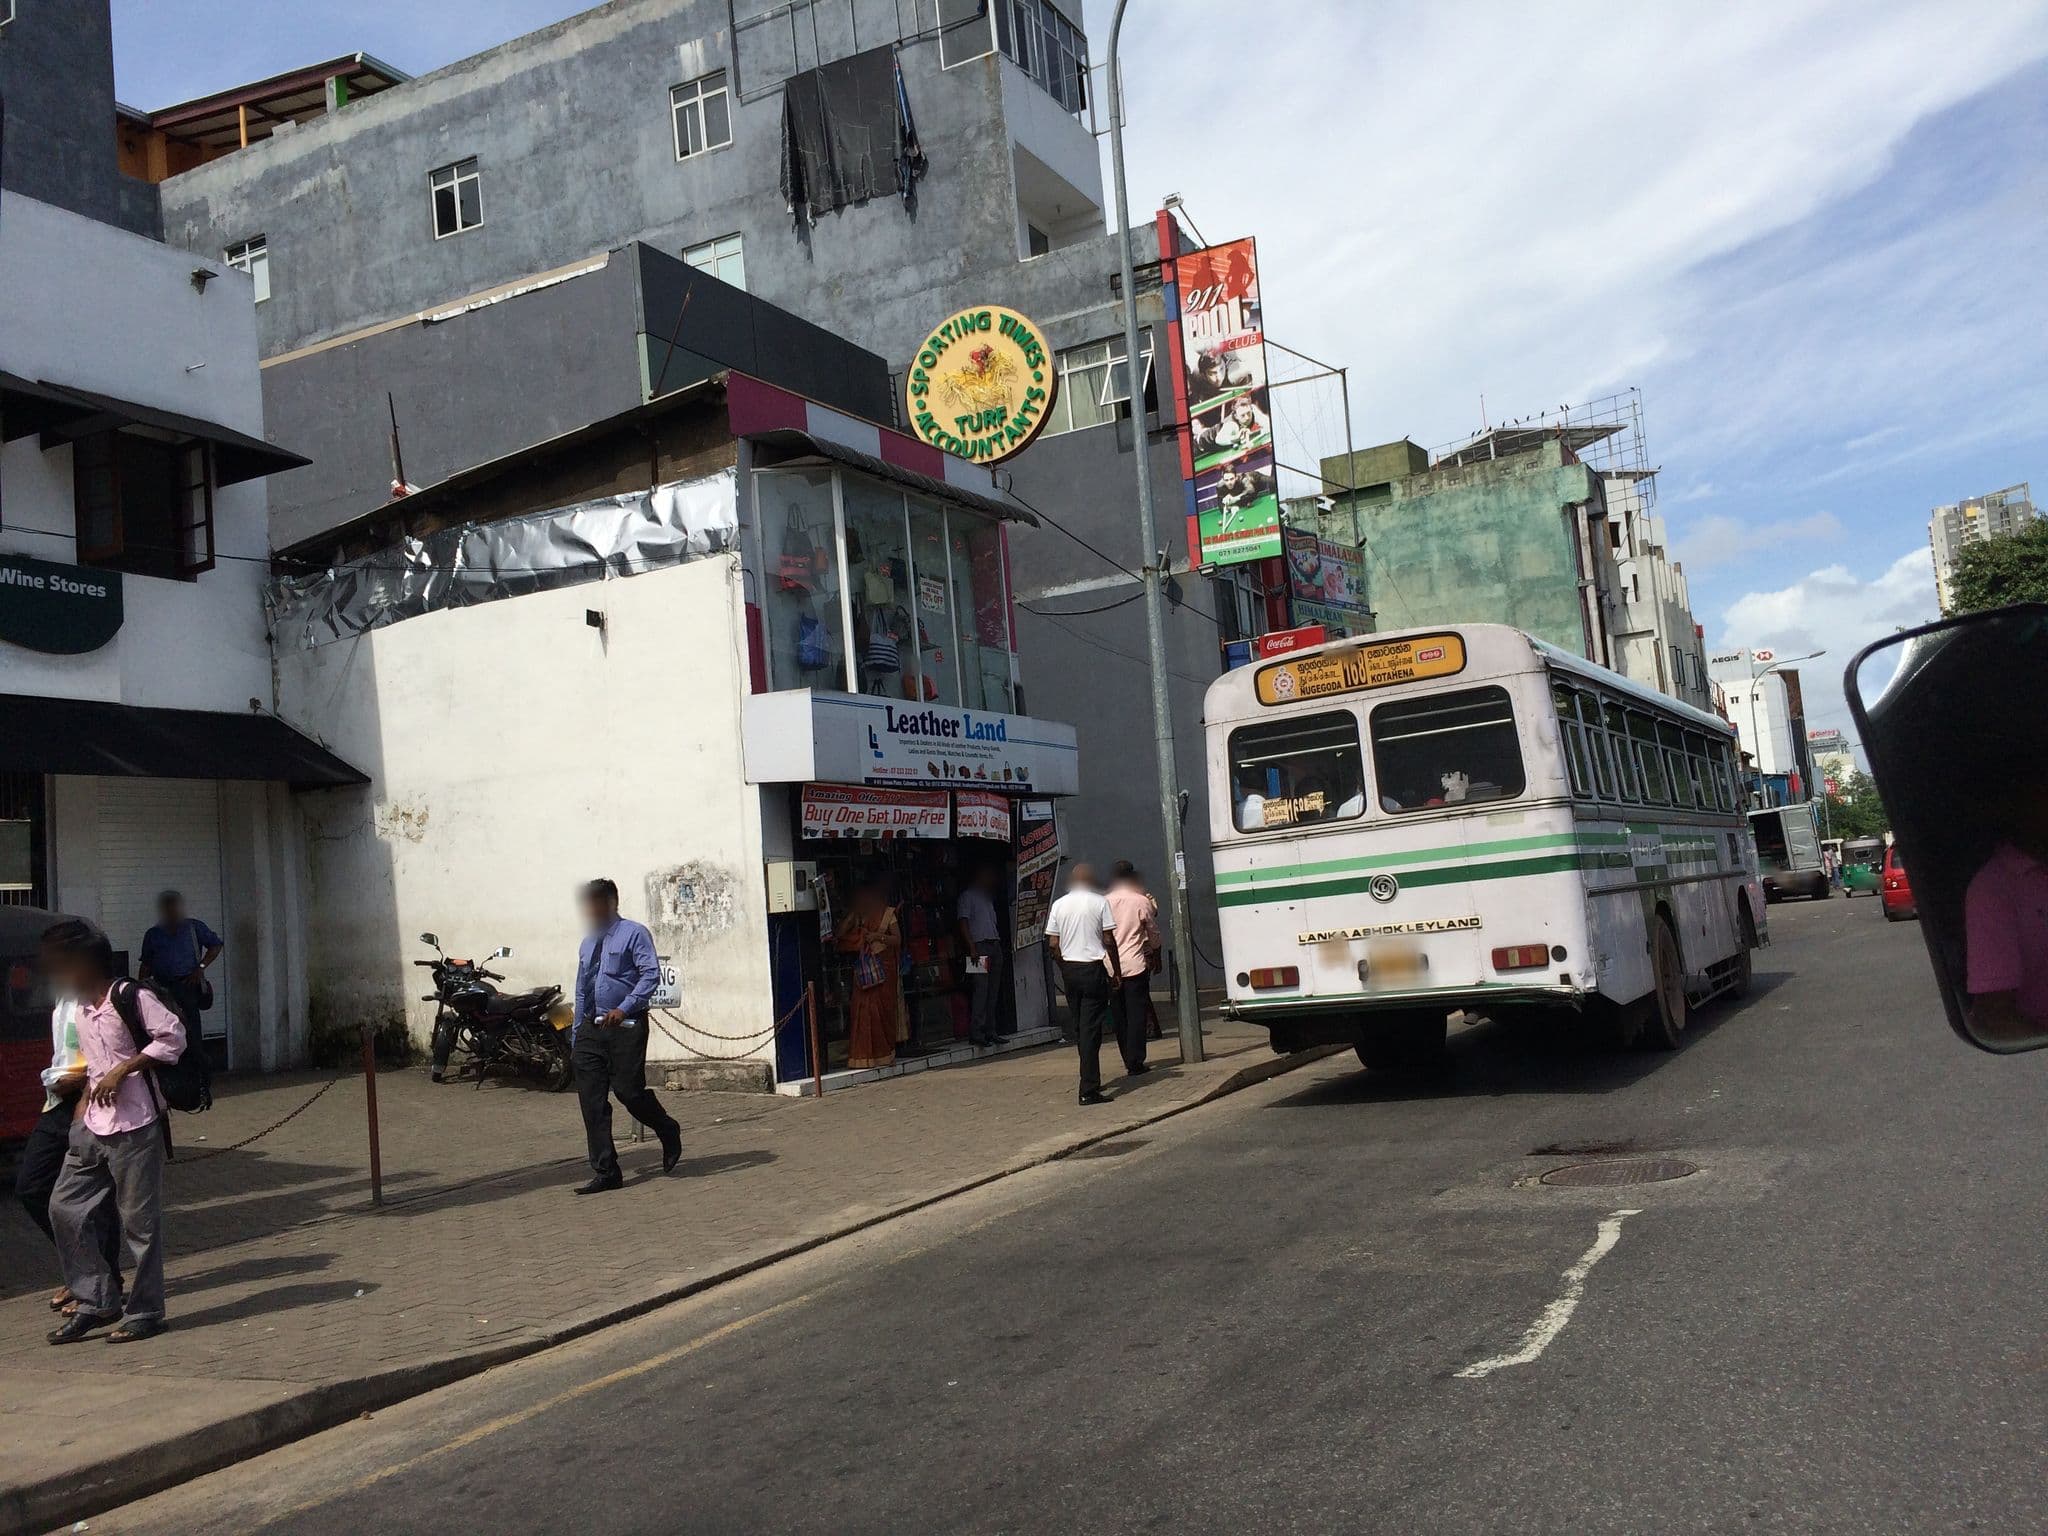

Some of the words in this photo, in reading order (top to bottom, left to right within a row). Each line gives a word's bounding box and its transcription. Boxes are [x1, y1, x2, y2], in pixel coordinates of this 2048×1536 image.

[1186, 282, 1224, 313] 911
[1188, 295, 1256, 341] POOL
[910, 311, 992, 397] SPORTING
[998, 312, 1046, 370] TIMES
[1228, 334, 1258, 350] CLUB
[915, 386, 1046, 459] ACCOUNTANTS
[954, 405, 1008, 436] TURF
[0, 568, 44, 588] Wine
[50, 574, 106, 598] Stores
[1711, 654, 1740, 664] AEGIS
[1299, 683, 1342, 696] NUGEGODA
[1369, 668, 1415, 683] KOTAHENA
[885, 705, 960, 738] Leather
[963, 713, 1007, 742] Land
[804, 805, 832, 826] Buy
[834, 806, 864, 824] One
[867, 808, 890, 825] Get
[893, 809, 916, 825] One
[917, 810, 945, 826] Free
[1352, 925, 1404, 938] ASHOK
[1406, 917, 1480, 932] LEYLAND
